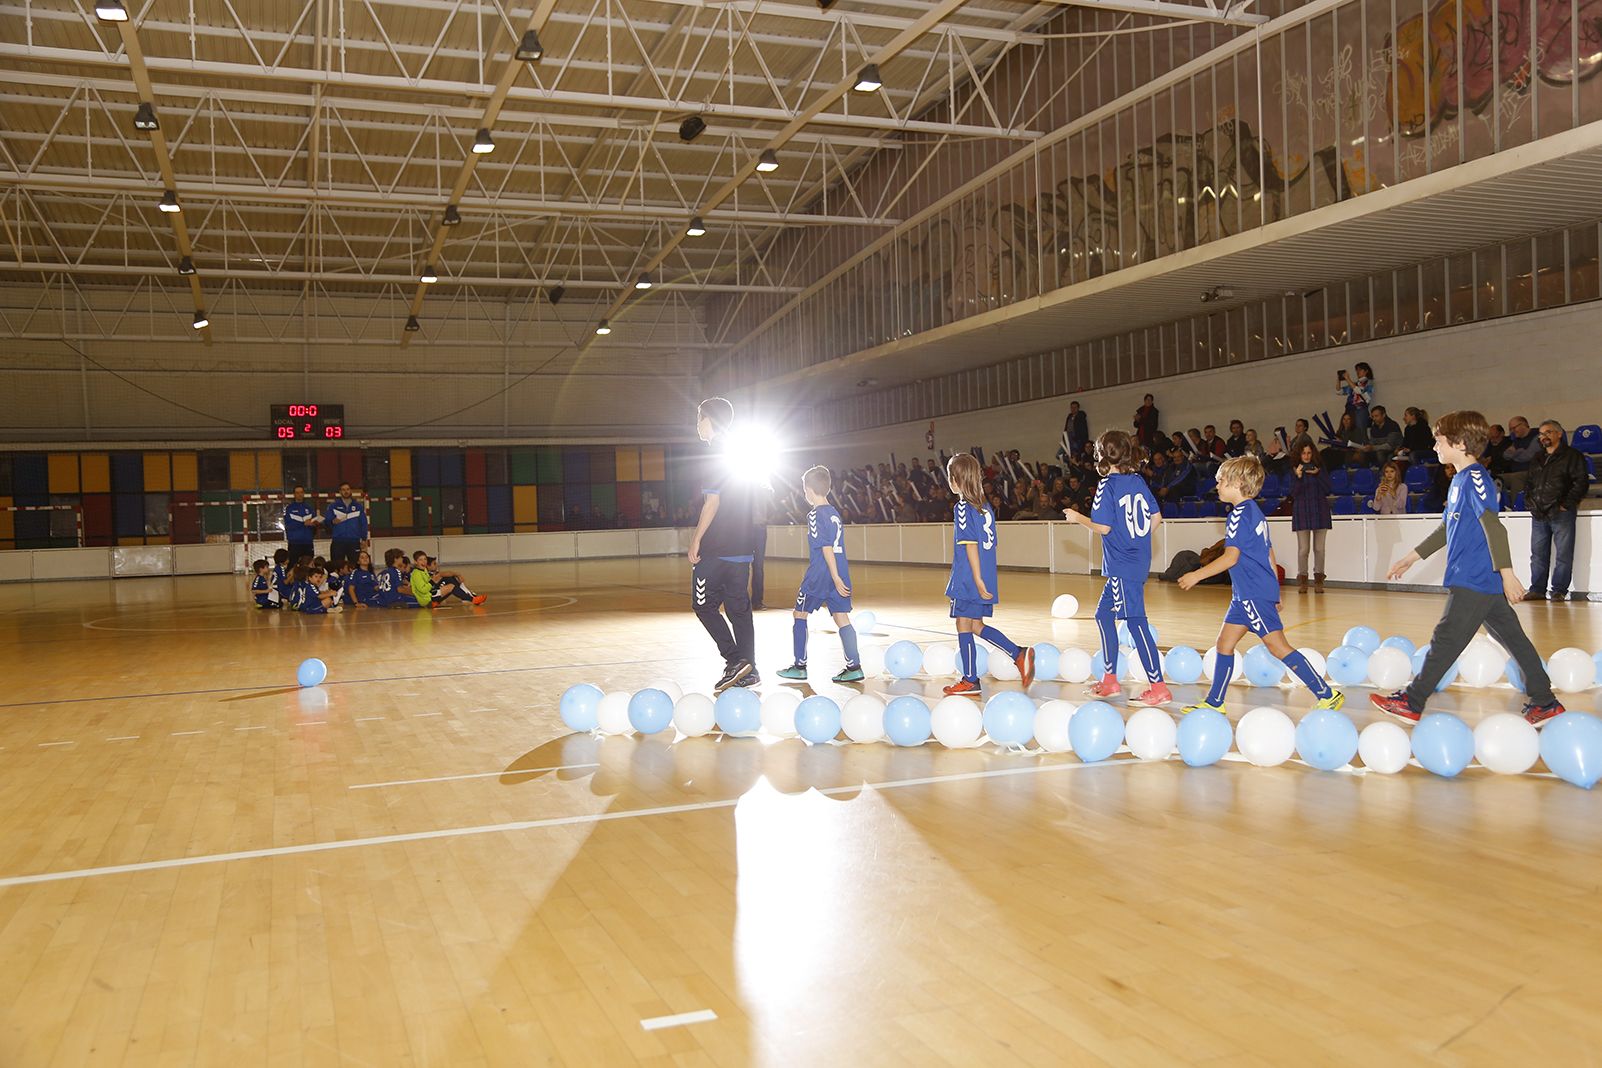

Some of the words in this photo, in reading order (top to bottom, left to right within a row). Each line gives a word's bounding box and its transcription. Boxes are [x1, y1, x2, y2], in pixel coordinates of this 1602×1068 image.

[289, 405, 317, 417] 00:0
[278, 427, 294, 438] 05
[304, 423, 312, 432] 2
[325, 427, 342, 438] 03
[1119, 493, 1151, 539] 10
[830, 515, 843, 554] 2
